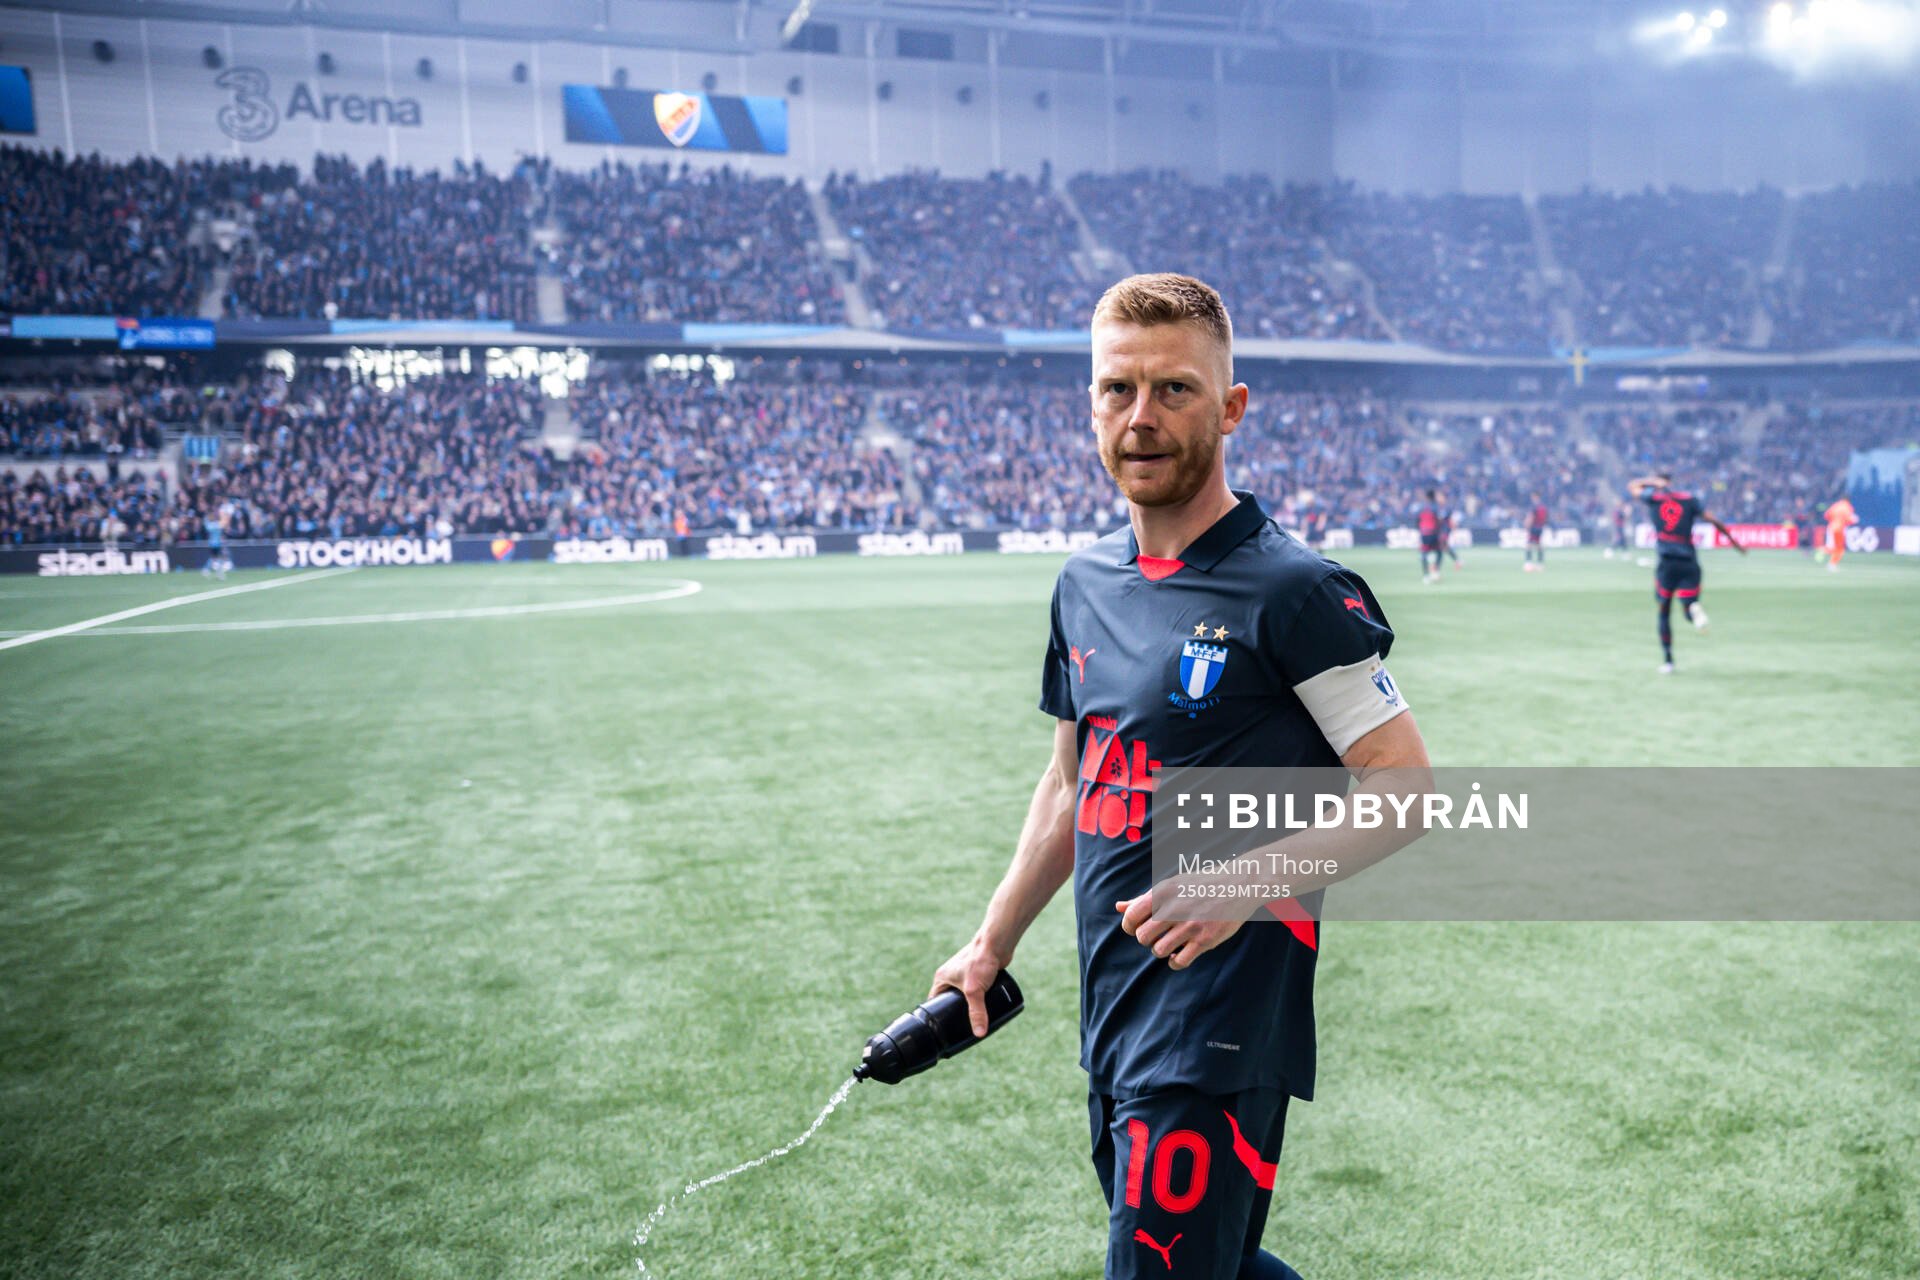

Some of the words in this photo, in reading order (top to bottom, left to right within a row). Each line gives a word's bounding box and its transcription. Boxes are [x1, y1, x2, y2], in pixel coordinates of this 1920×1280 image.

[285, 81, 423, 127] Arena
[1659, 499, 1683, 532] 9
[277, 538, 452, 568] STOCKHOLM
[553, 536, 668, 564] stadium
[706, 532, 817, 561] stadium
[857, 530, 964, 556] stadium
[38, 547, 170, 577] stadium
[1125, 1118, 1211, 1214] 10
